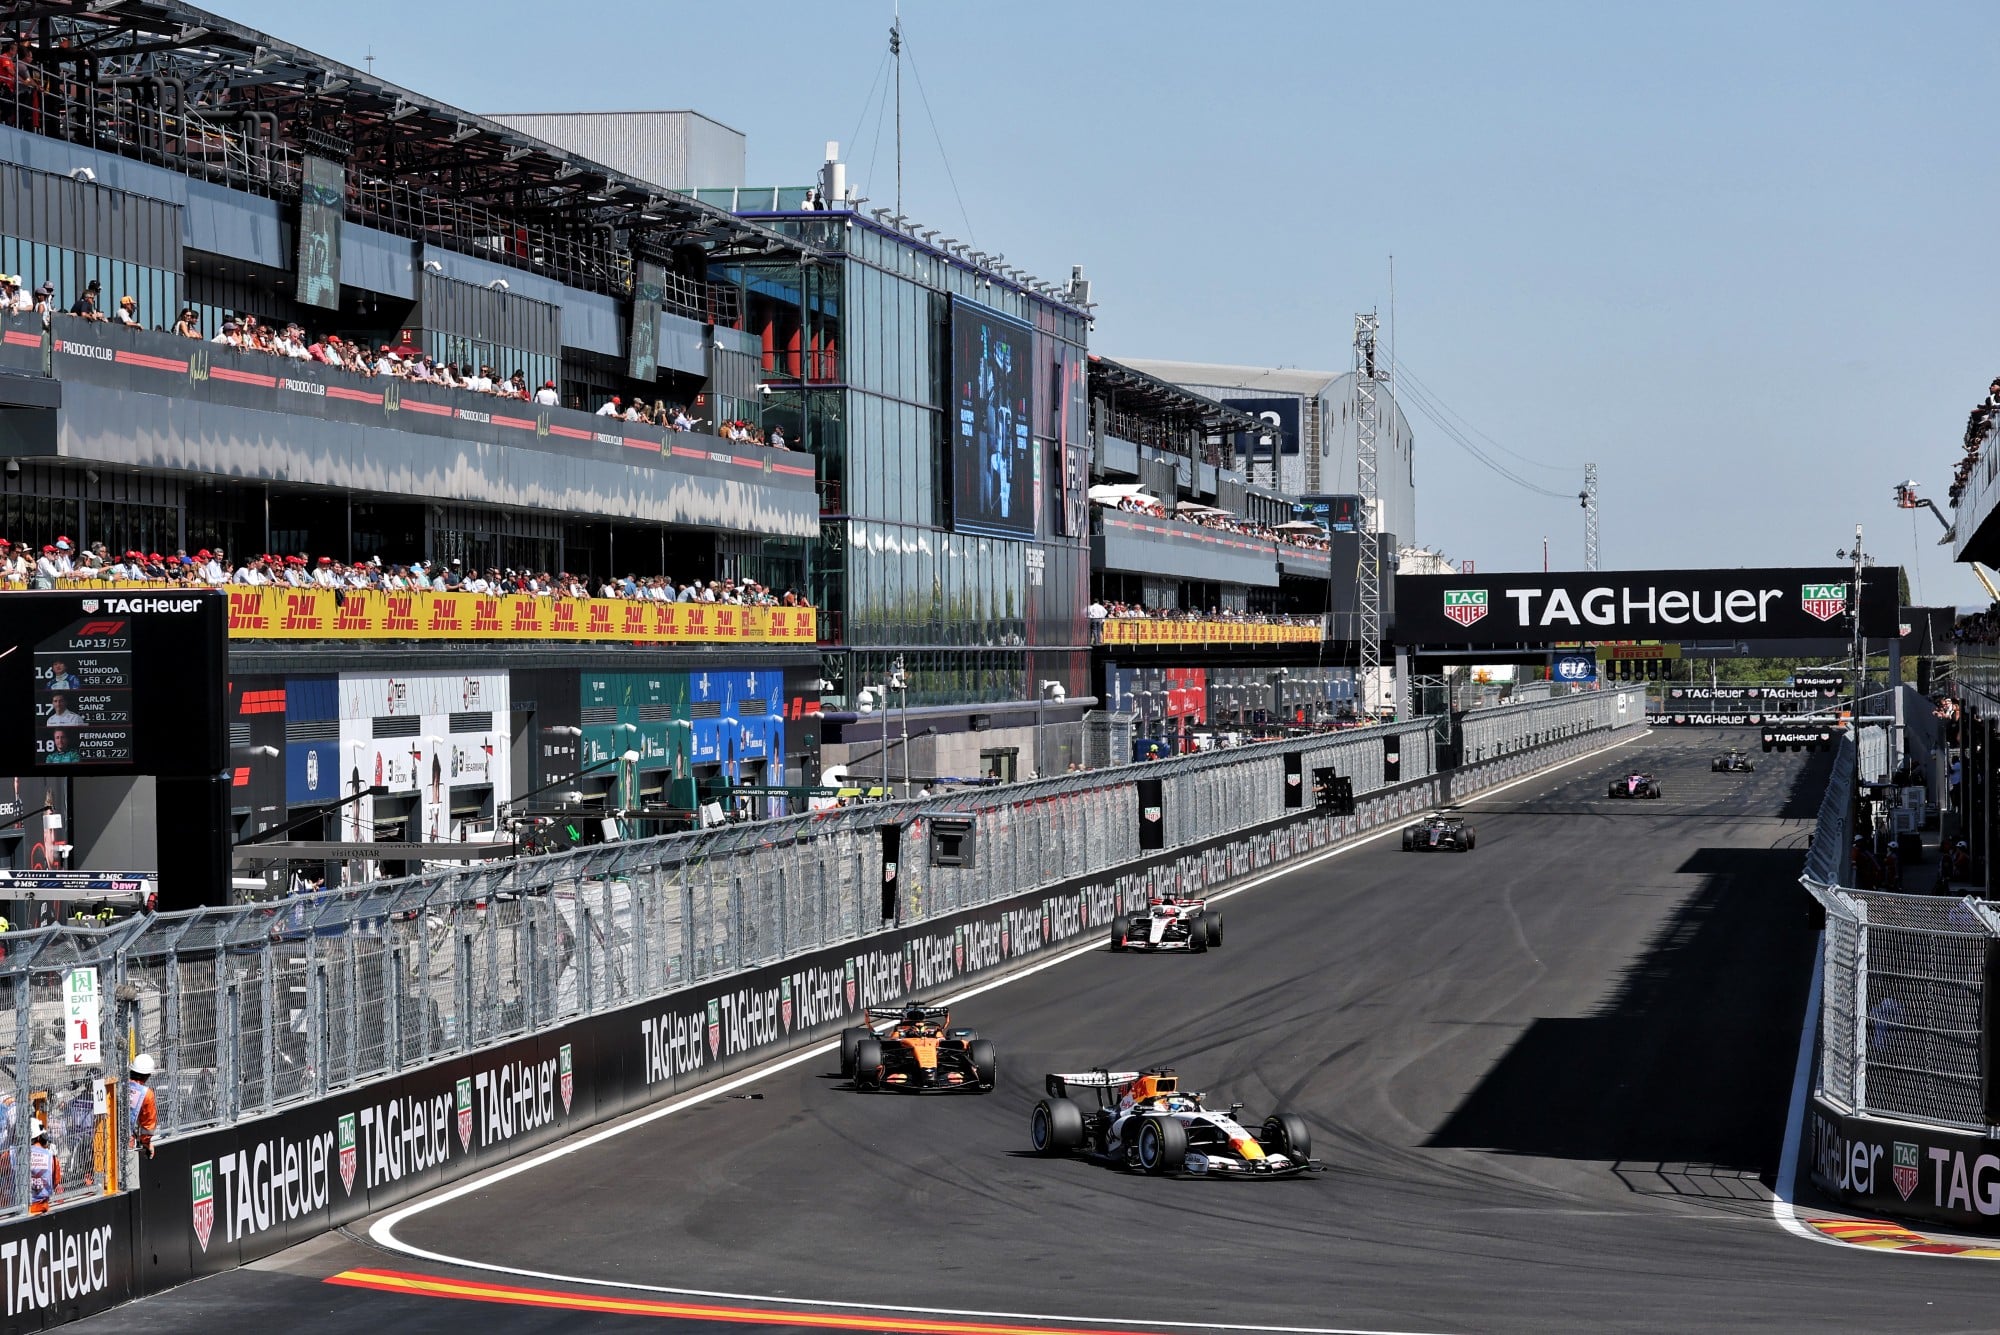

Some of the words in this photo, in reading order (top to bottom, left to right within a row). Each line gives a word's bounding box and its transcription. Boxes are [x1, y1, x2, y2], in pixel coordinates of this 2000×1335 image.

[63, 340, 95, 358] PADDOCK
[95, 347, 113, 361] CLUB
[285, 379, 311, 393] PADDOCK
[310, 383, 325, 395] CLUB
[1449, 592, 1485, 604] TAG
[1804, 584, 1844, 598] TAG
[104, 598, 202, 613] TAGHeuer
[1446, 605, 1488, 624] HEUER
[1506, 587, 1784, 626] TAGHeuer
[1803, 599, 1846, 618] HEUER
[69, 639, 91, 648] LAP
[35, 667, 54, 679] 16
[1561, 662, 1588, 674] FIA
[83, 676, 123, 684] +58.670
[35, 704, 54, 716] 17
[36, 741, 55, 753] 18
[80, 749, 128, 757] +1:01.727
[71, 994, 94, 1004] EXIT
[793, 966, 845, 1031] TAGHeuer
[721, 988, 779, 1056] TAGHeuer
[73, 1041, 96, 1051] FIRE
[642, 1011, 705, 1084] TAGHeuer
[561, 1048, 571, 1071] TAG
[95, 1089, 104, 1103] 10
[457, 1082, 470, 1109] TAG
[475, 1057, 557, 1147] TAGHeuer
[339, 1119, 354, 1147] TAG
[360, 1092, 453, 1188] TAGHeuer
[1895, 1145, 1918, 1165] TAG
[340, 1150, 356, 1188] HEUER
[193, 1166, 212, 1197] TAG
[219, 1130, 334, 1243] TAGHeuer
[1894, 1169, 1918, 1197] HEUER
[1928, 1147, 2000, 1216] TAG
[193, 1201, 213, 1244] HEUER
[1, 1222, 112, 1316] TAGHeuer
